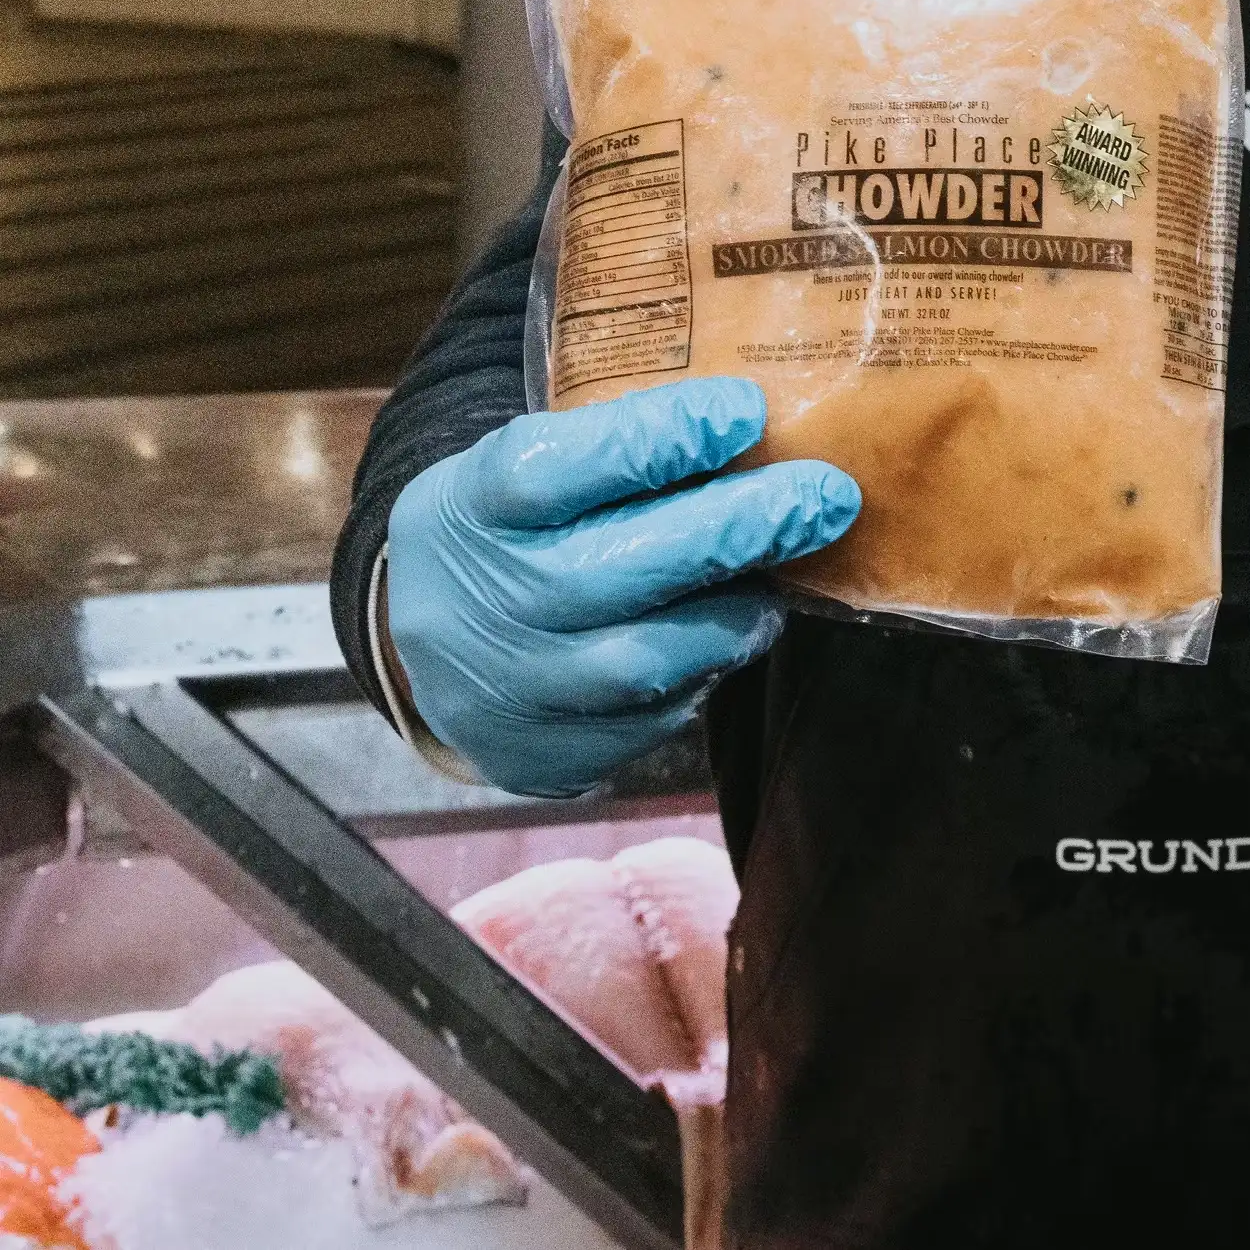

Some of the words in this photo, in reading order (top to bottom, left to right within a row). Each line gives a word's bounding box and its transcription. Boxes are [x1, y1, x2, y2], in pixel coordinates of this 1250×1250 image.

[831, 115, 872, 127] Serving
[934, 113, 955, 124] Best
[958, 112, 1009, 125] Chowder
[607, 133, 640, 152] Facts
[797, 130, 886, 167] Pike
[925, 127, 1041, 165] Place
[1076, 122, 1133, 162] AWARD
[1062, 144, 1131, 191] WINNING
[795, 172, 1042, 226] CHOWDER
[980, 235, 1125, 266] CHOWDER
[813, 272, 833, 285] There
[843, 271, 872, 285] nothing
[902, 270, 910, 280] to
[912, 271, 925, 280] our
[927, 269, 953, 281] award
[955, 269, 987, 284] winning
[988, 270, 1024, 283] chowder!
[838, 286, 868, 302] JUST
[916, 286, 942, 299] AND
[951, 286, 997, 300] SERVE!
[881, 308, 896, 320] NET
[916, 308, 928, 319] 32
[929, 308, 938, 319] FL
[940, 308, 951, 320] OZ
[913, 326, 931, 336] Pike
[933, 326, 956, 337] Place
[957, 327, 996, 338] Chowder
[1003, 350, 1021, 359] Pike
